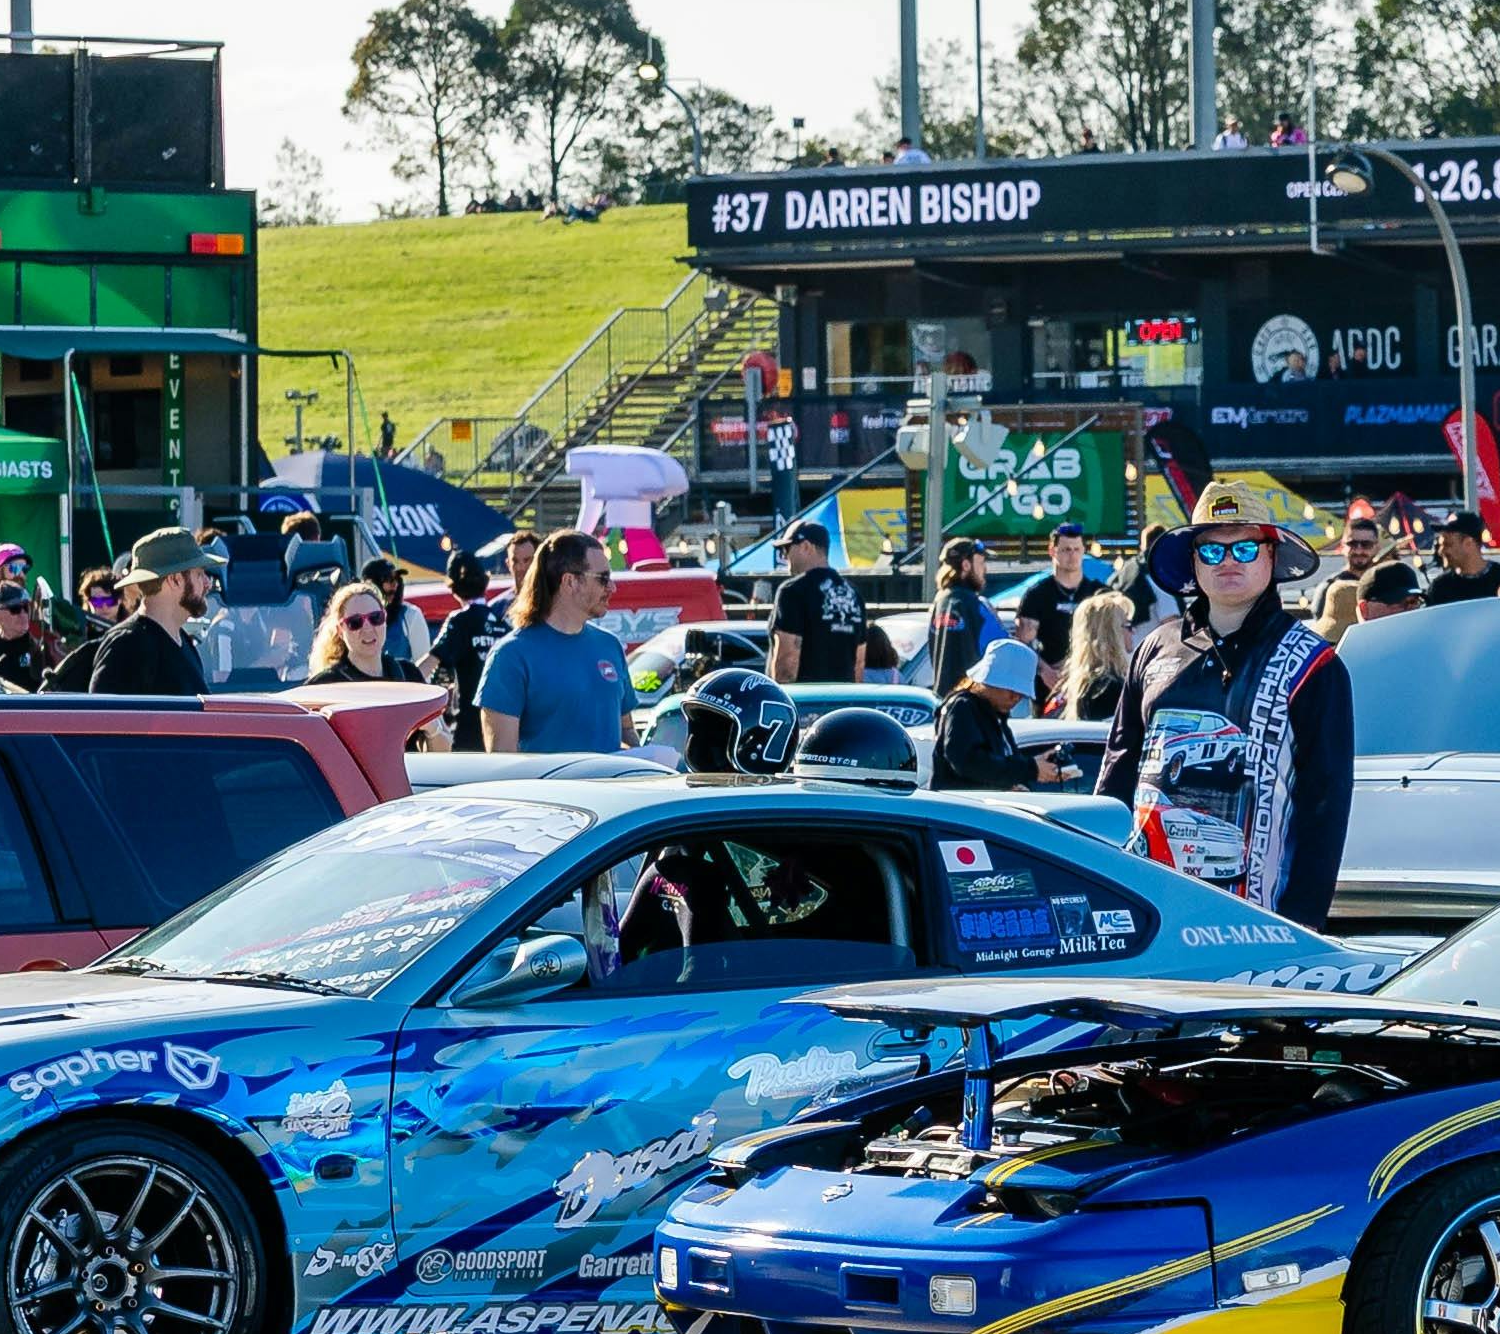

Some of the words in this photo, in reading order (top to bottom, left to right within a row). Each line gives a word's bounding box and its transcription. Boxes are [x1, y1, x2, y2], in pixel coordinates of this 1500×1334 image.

[712, 192, 768, 234] #37
[785, 185, 912, 232] DARREN
[918, 179, 1042, 226] BISHOP
[1138, 320, 1182, 342] OPEN
[958, 447, 1082, 481] GRAB
[1266, 630, 1322, 743] MOUNT
[1243, 627, 1302, 785] BATHURST
[759, 700, 798, 763] 7
[1168, 823, 1200, 839] Castrol
[1245, 745, 1280, 911] PANORAM
[1060, 937, 1096, 955] Milk
[1098, 935, 1127, 951] Tea
[1181, 924, 1296, 948] ONI-MAKE
[975, 948, 1019, 963] Midnight
[1021, 947, 1056, 959] Garage
[7, 1042, 157, 1100] sapher
[455, 1249, 548, 1270] GOODSPORT
[452, 1269, 546, 1282] FABRICATION
